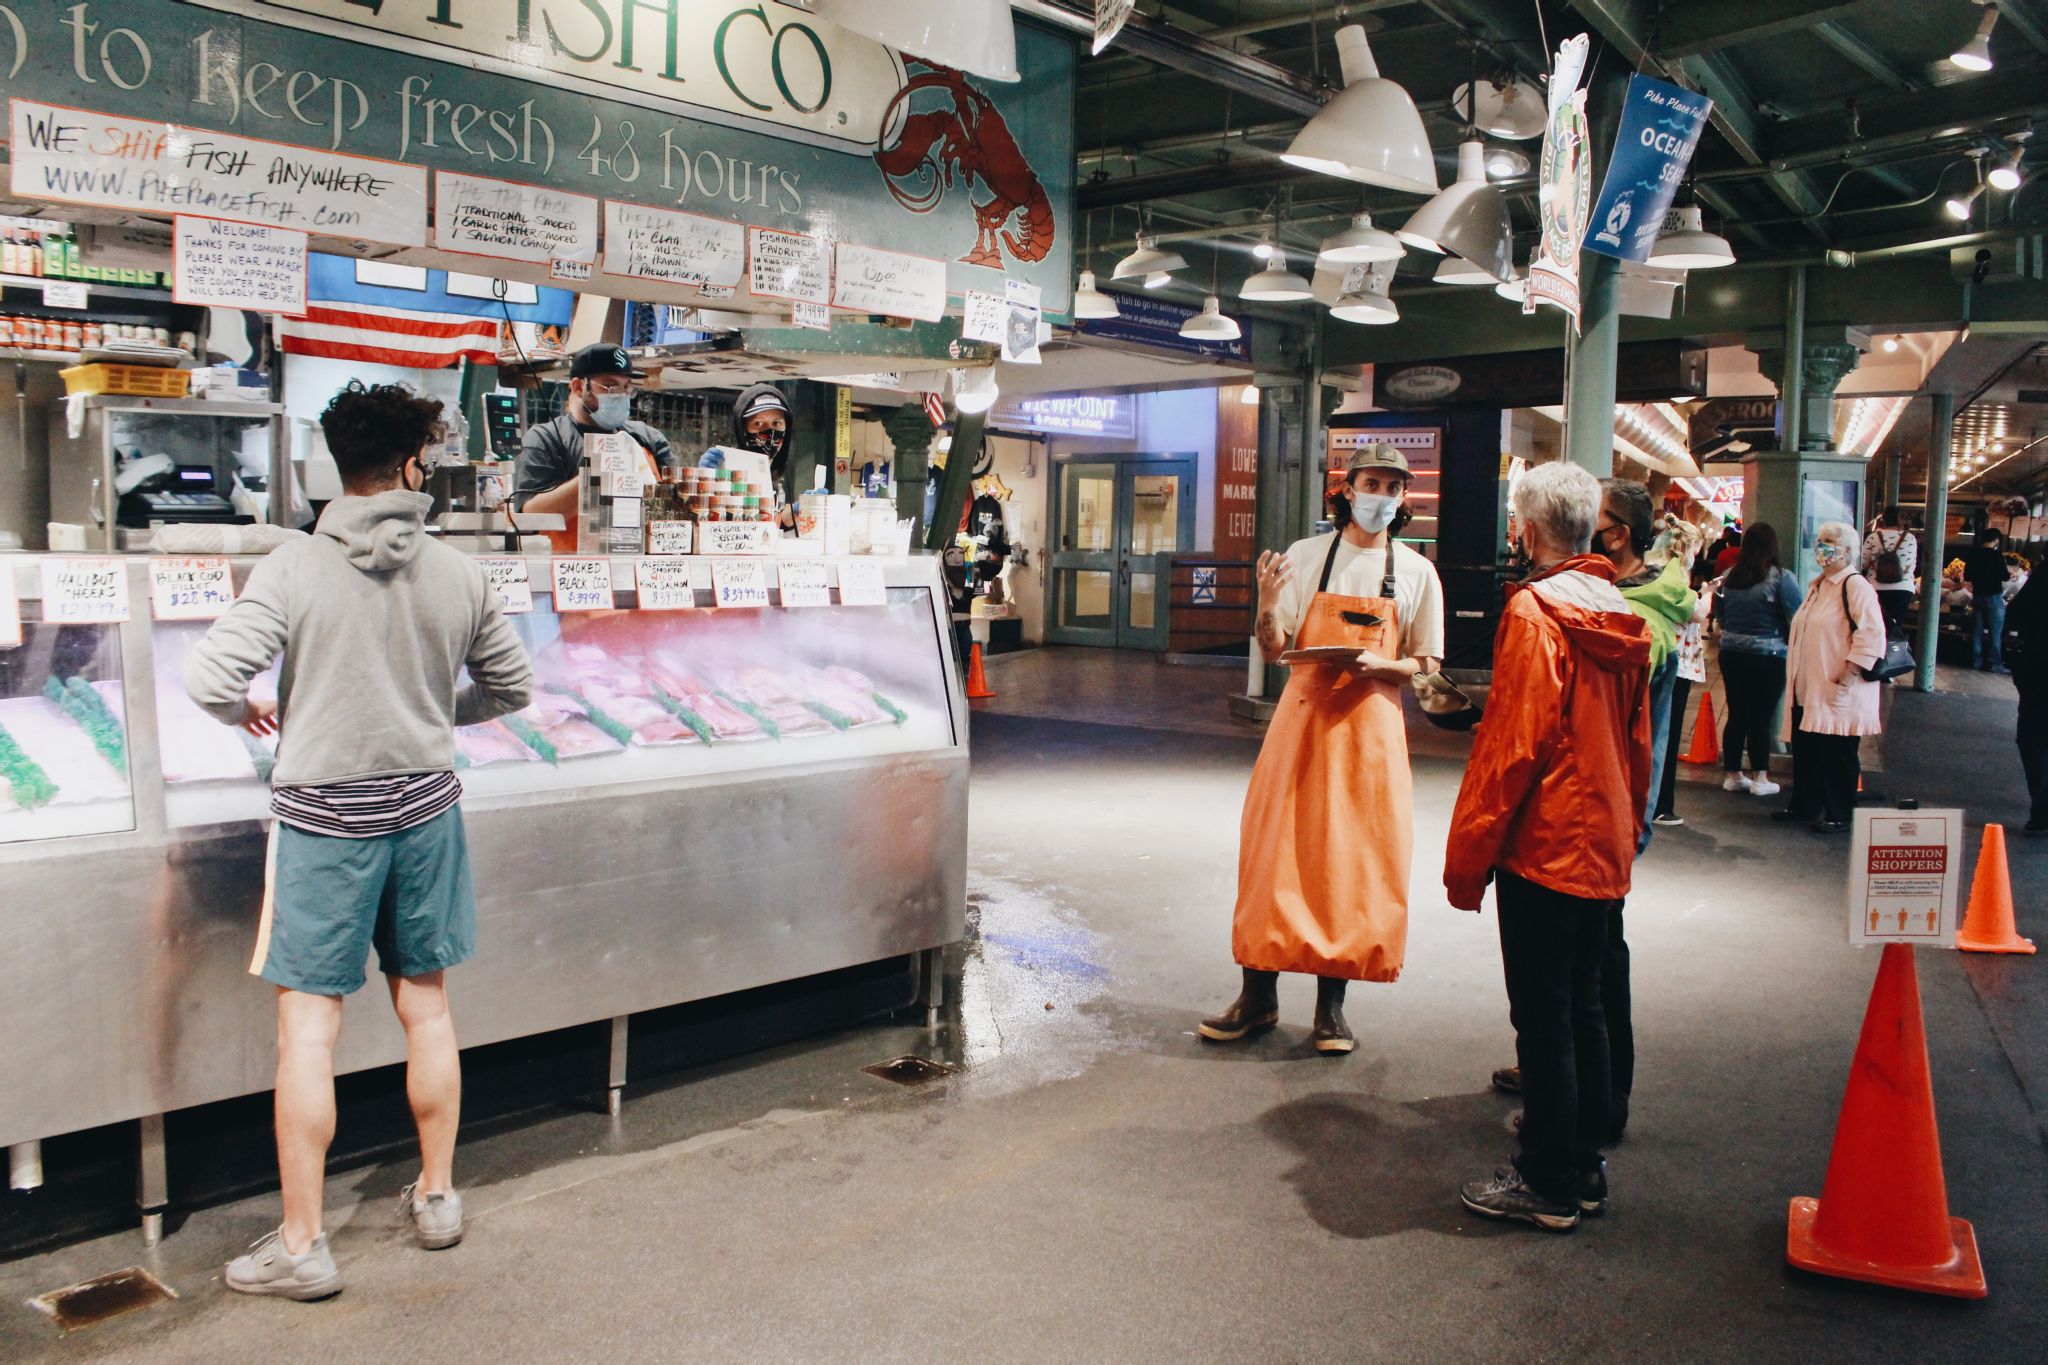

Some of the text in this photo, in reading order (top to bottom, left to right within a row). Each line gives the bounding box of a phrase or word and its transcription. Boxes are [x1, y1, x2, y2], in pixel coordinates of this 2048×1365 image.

[714, 3, 848, 125] CO.
[59, 2, 151, 90] to
[394, 76, 555, 176] fresh
[577, 114, 640, 183] 48
[658, 127, 802, 216] hours
[1644, 89, 1666, 105] Pike
[1666, 97, 1691, 114] Place
[27, 111, 88, 153] WE
[186, 142, 256, 178] FISH
[267, 156, 394, 197] ANYWHERE
[461, 205, 531, 223] TRADITIONAL
[536, 215, 577, 231] SMOKED
[208, 220, 271, 239] WELCOME!
[461, 216, 498, 231] GARLIC
[538, 230, 578, 244] SMOKED
[184, 235, 222, 249] THANKS
[229, 241, 246, 250] FOR
[252, 244, 286, 255] COMING
[465, 229, 517, 246] SALMON
[520, 238, 556, 254] CANDY
[185, 250, 223, 264] PLEASE
[230, 256, 260, 266] WEAR
[276, 260, 302, 273] MASK
[187, 265, 291, 281] WHEN YOU APPROACH
[187, 275, 293, 293] THE COUNTER AND WE
[189, 287, 214, 296] WILL
[218, 287, 254, 297] GLADLY
[258, 291, 279, 300] HELP
[1121, 295, 1134, 306] fish
[1134, 298, 1142, 306] to
[1142, 301, 1152, 310] go
[1232, 447, 1256, 472] LOWE
[1223, 484, 1256, 500] MARK
[559, 563, 601, 575] SMOKED
[716, 560, 756, 575] SALMON
[56, 571, 118, 587] HALIBUT
[156, 571, 223, 584] BLACK COD
[559, 576, 609, 590] BLACK COD
[660, 579, 688, 589] SALMON
[722, 573, 753, 585] CANDY
[1872, 849, 1944, 858] ATTENTION
[1871, 860, 1943, 870] SHOPPERS
